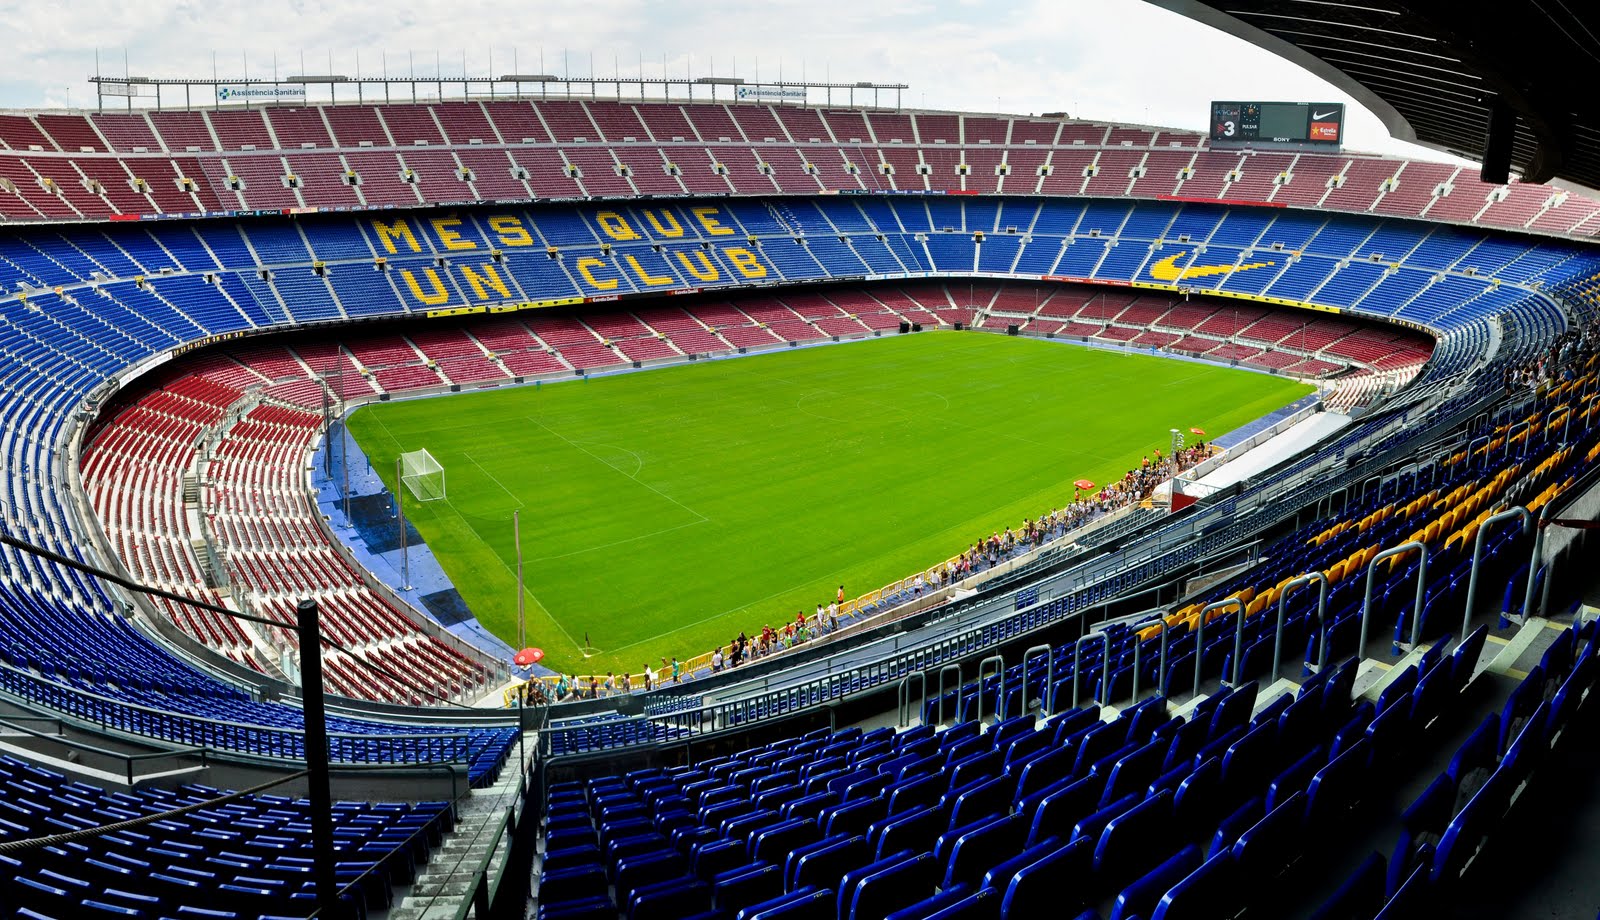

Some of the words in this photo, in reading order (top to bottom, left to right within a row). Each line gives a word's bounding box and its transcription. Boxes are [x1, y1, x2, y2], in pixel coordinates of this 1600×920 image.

[274, 88, 306, 96] Sanitària
[1224, 121, 1235, 136] 3
[596, 206, 735, 240] QUE
[399, 263, 512, 305] UN
[577, 247, 767, 290] CLUB
